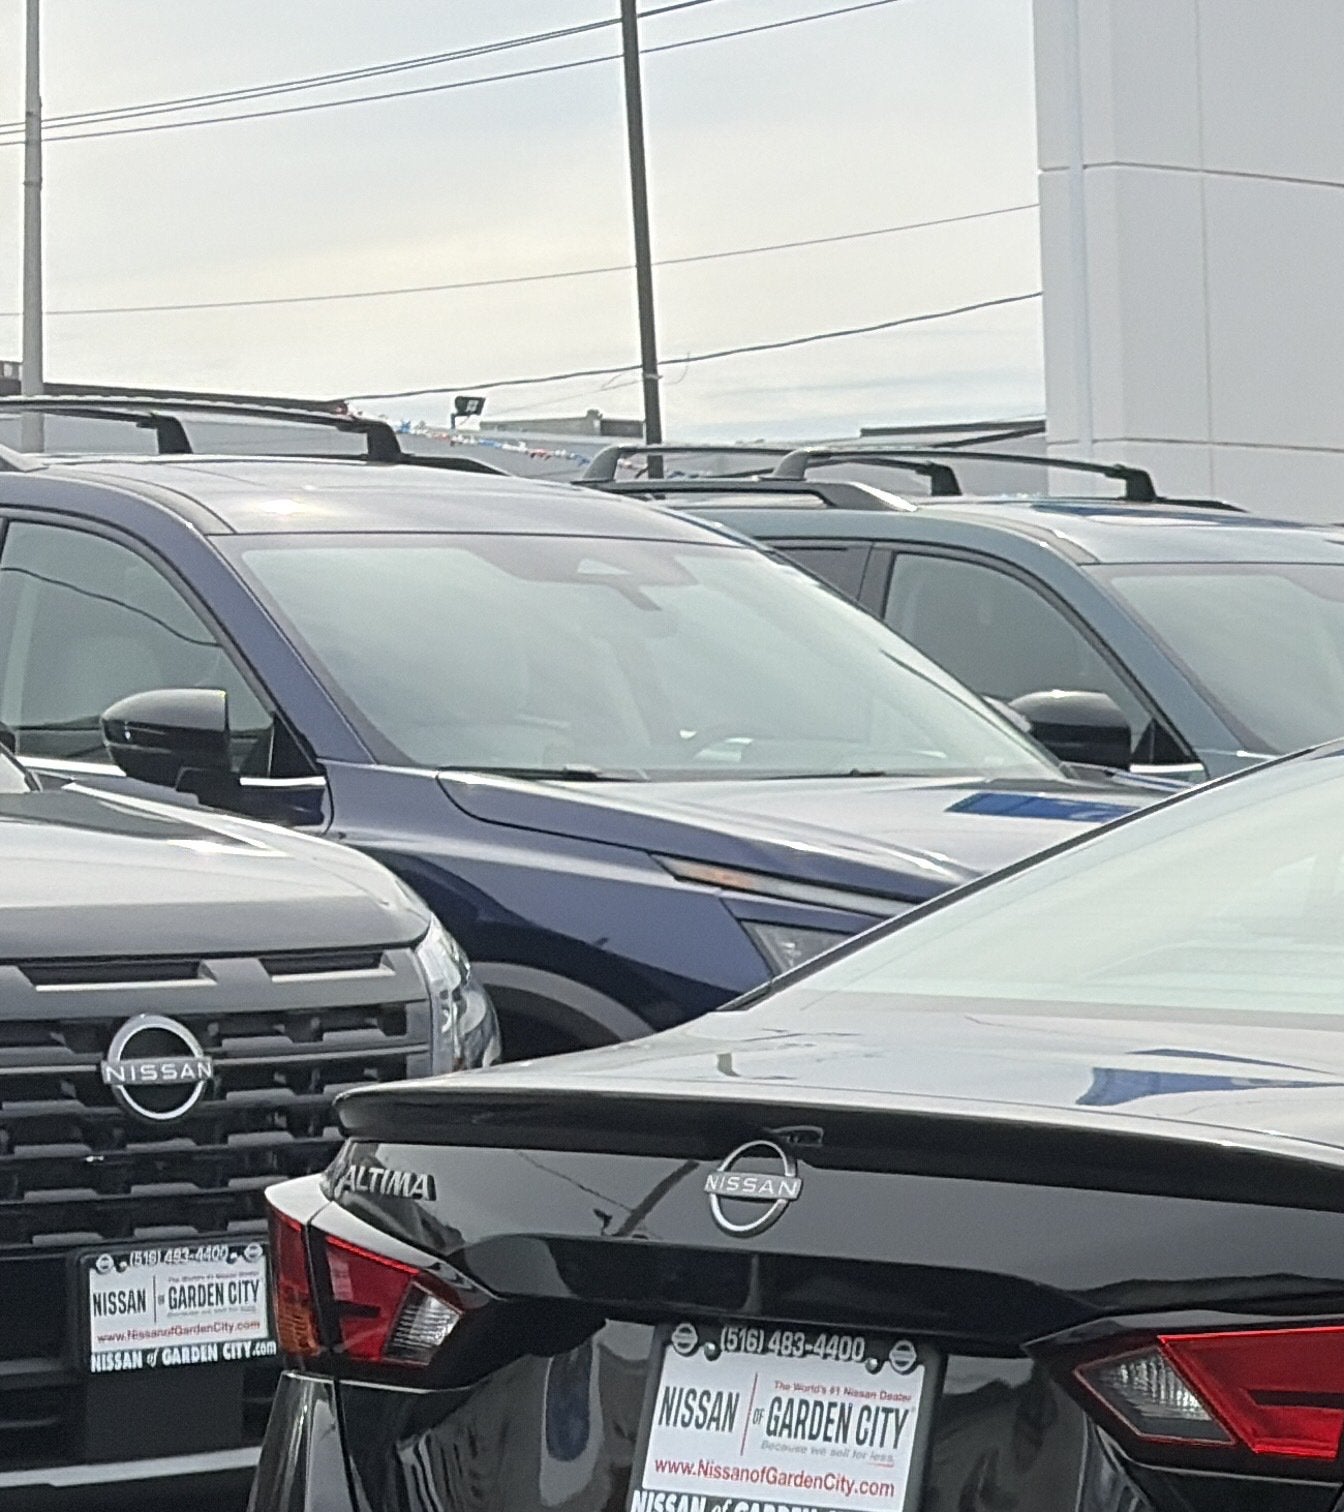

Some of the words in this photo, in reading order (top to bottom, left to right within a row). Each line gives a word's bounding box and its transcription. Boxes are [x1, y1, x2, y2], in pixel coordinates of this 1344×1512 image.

[105, 1060, 212, 1082] NISSAN
[334, 1165, 434, 1200] ALTIMA
[703, 1174, 799, 1196] NISSAN
[93, 1288, 146, 1317] NISSAN
[168, 1282, 224, 1310] GARDEN
[228, 1279, 259, 1305] CITY
[90, 1351, 143, 1373] NISSAN
[147, 1347, 159, 1368] of
[162, 1343, 218, 1366] GARDEN
[720, 1326, 764, 1353] (516)
[768, 1330, 865, 1361] 483-4400
[658, 1385, 740, 1434] NISSAN
[752, 1408, 764, 1425] OF
[766, 1396, 853, 1444] GARDEN
[856, 1404, 909, 1449] CITY
[655, 1459, 895, 1497] www.NissanofGardenCity.com
